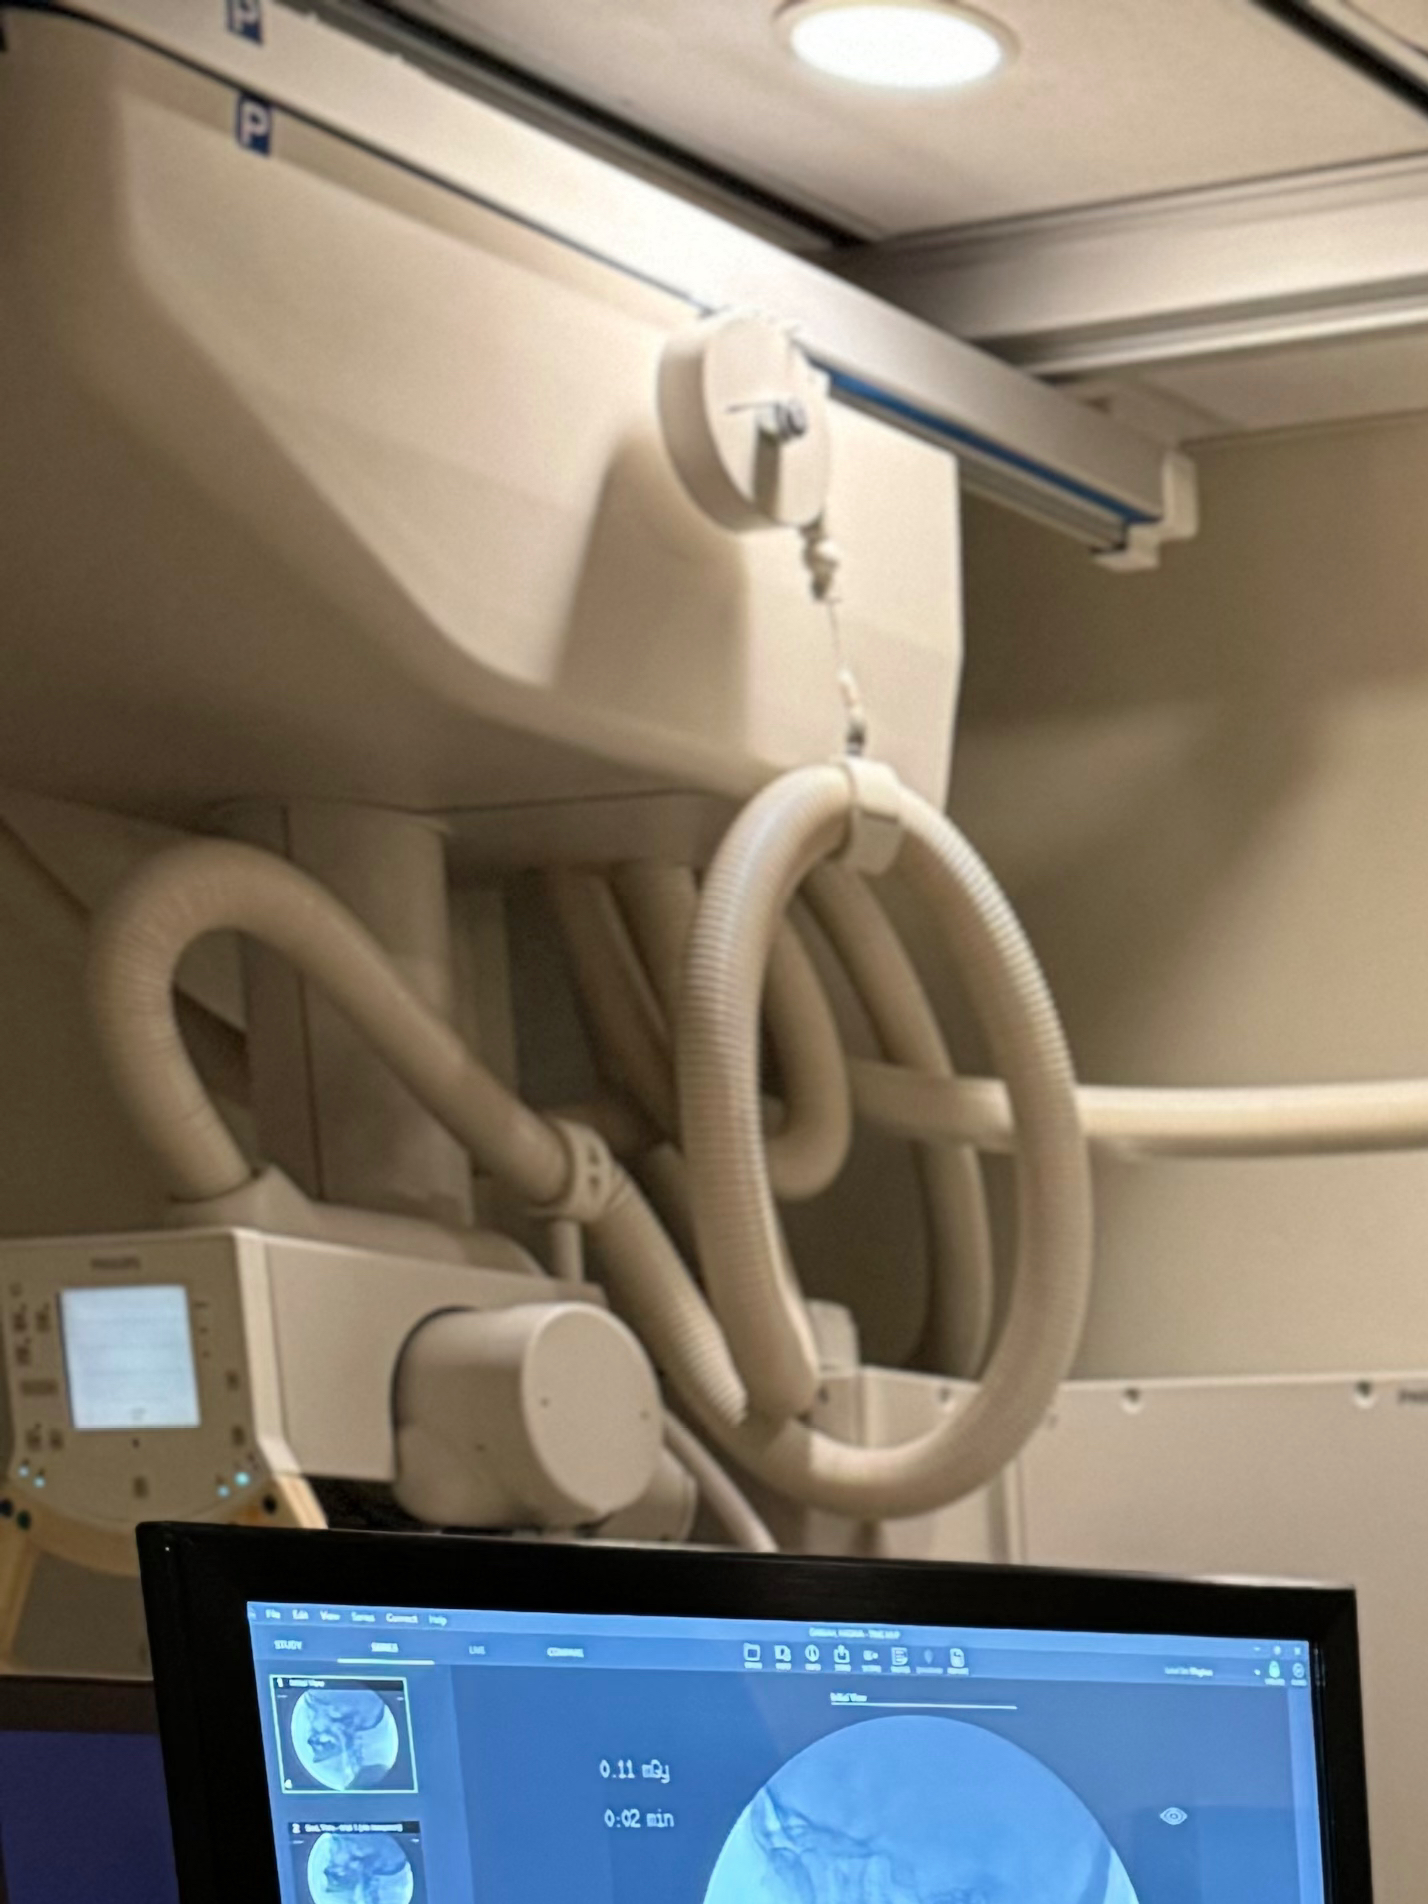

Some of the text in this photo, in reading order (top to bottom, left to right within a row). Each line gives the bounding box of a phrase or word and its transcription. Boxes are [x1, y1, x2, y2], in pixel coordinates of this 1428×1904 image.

[599, 1759, 635, 1779] 0.11
[604, 1808, 674, 1828] 0:02 min
